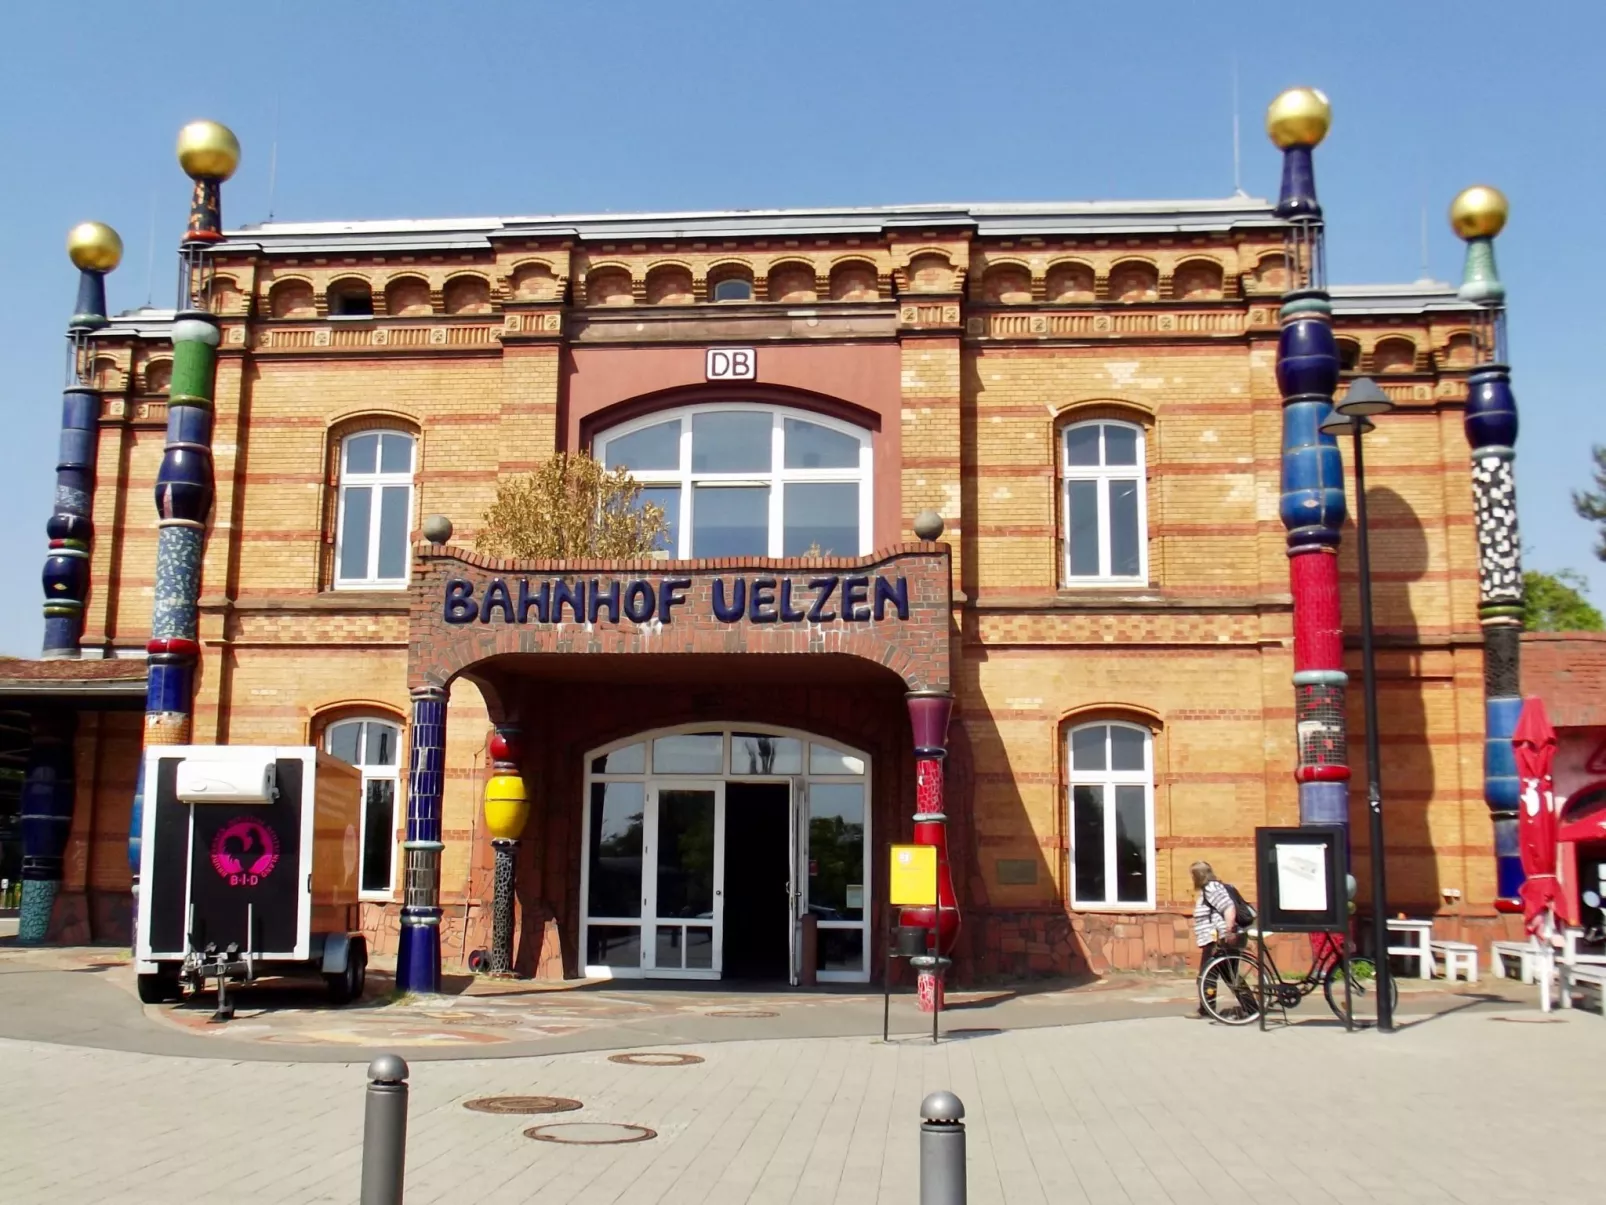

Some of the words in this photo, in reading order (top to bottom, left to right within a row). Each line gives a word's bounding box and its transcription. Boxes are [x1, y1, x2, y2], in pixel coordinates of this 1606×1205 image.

[711, 352, 749, 376] DB
[444, 577, 690, 624] BAHNHOF
[712, 576, 909, 623] UELZEN
